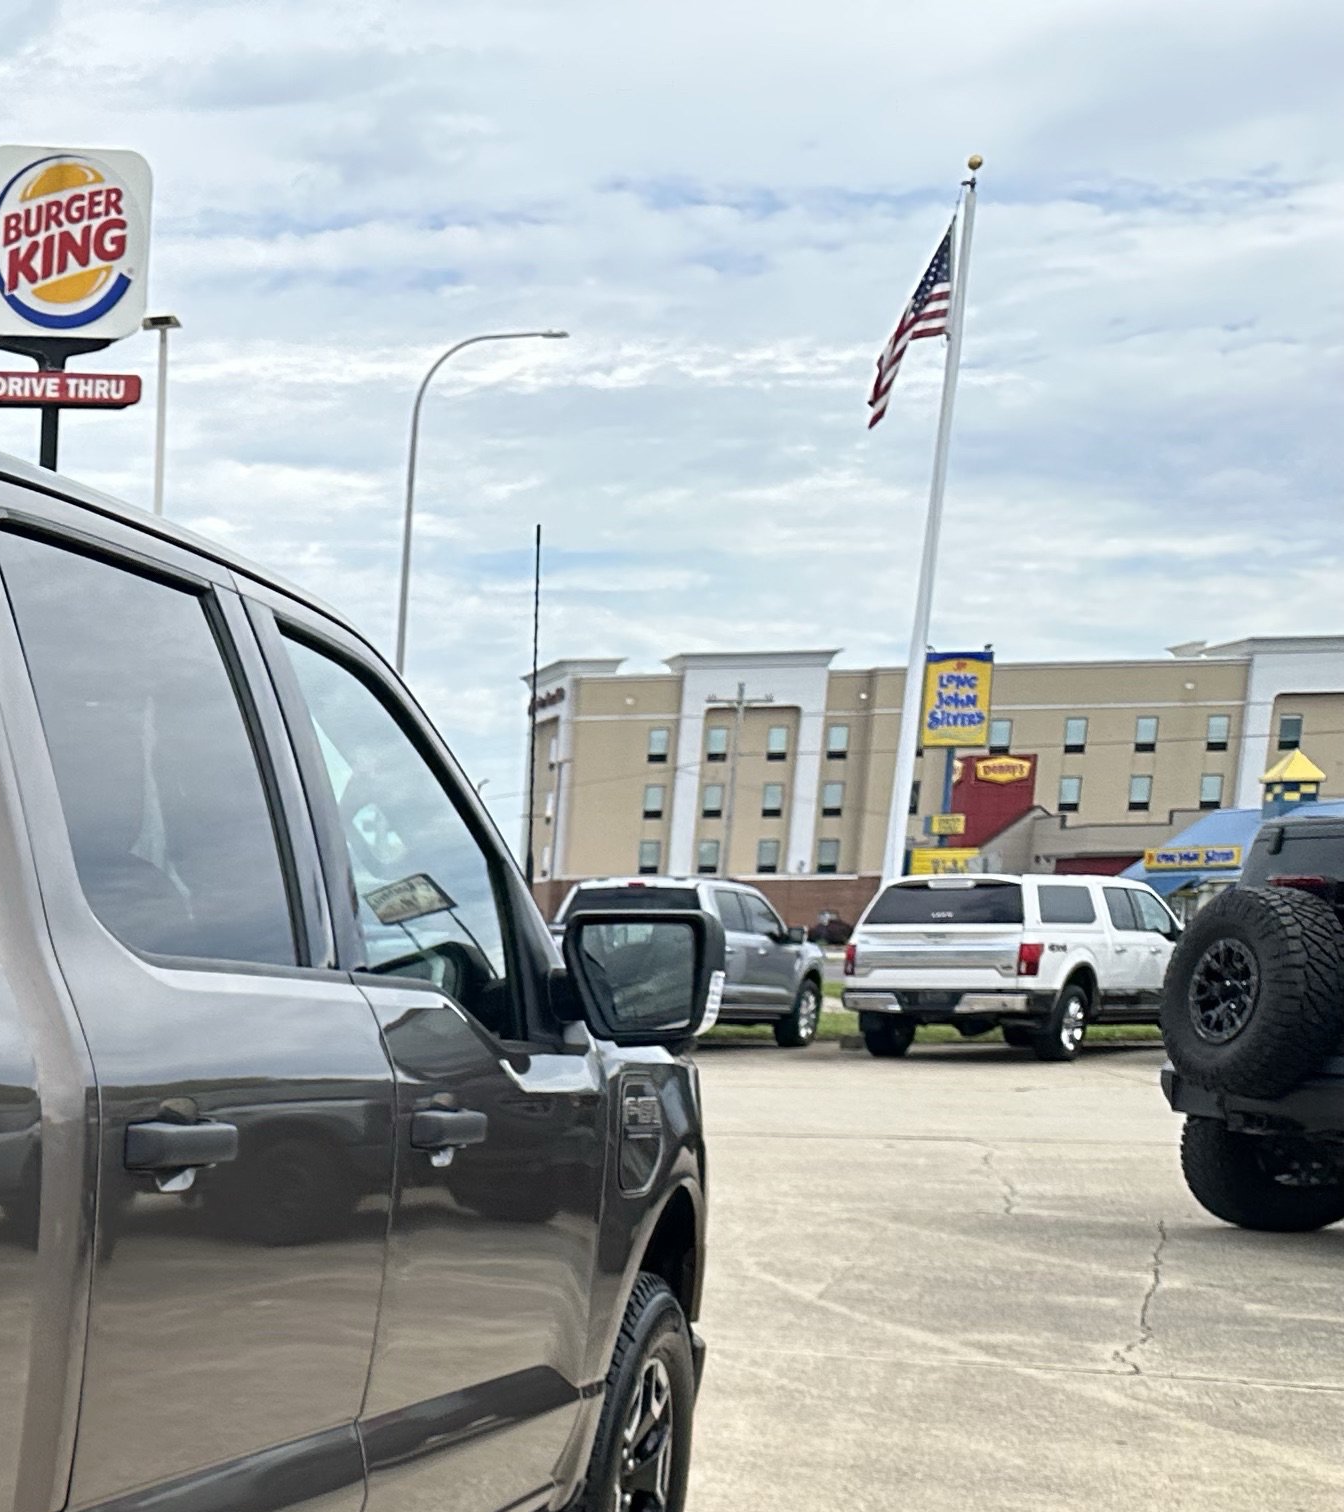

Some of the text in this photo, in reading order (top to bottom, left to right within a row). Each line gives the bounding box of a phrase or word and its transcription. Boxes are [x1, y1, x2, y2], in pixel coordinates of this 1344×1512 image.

[2, 187, 124, 248] BURGER
[7, 218, 128, 294] KING
[67, 377, 125, 399] THRU
